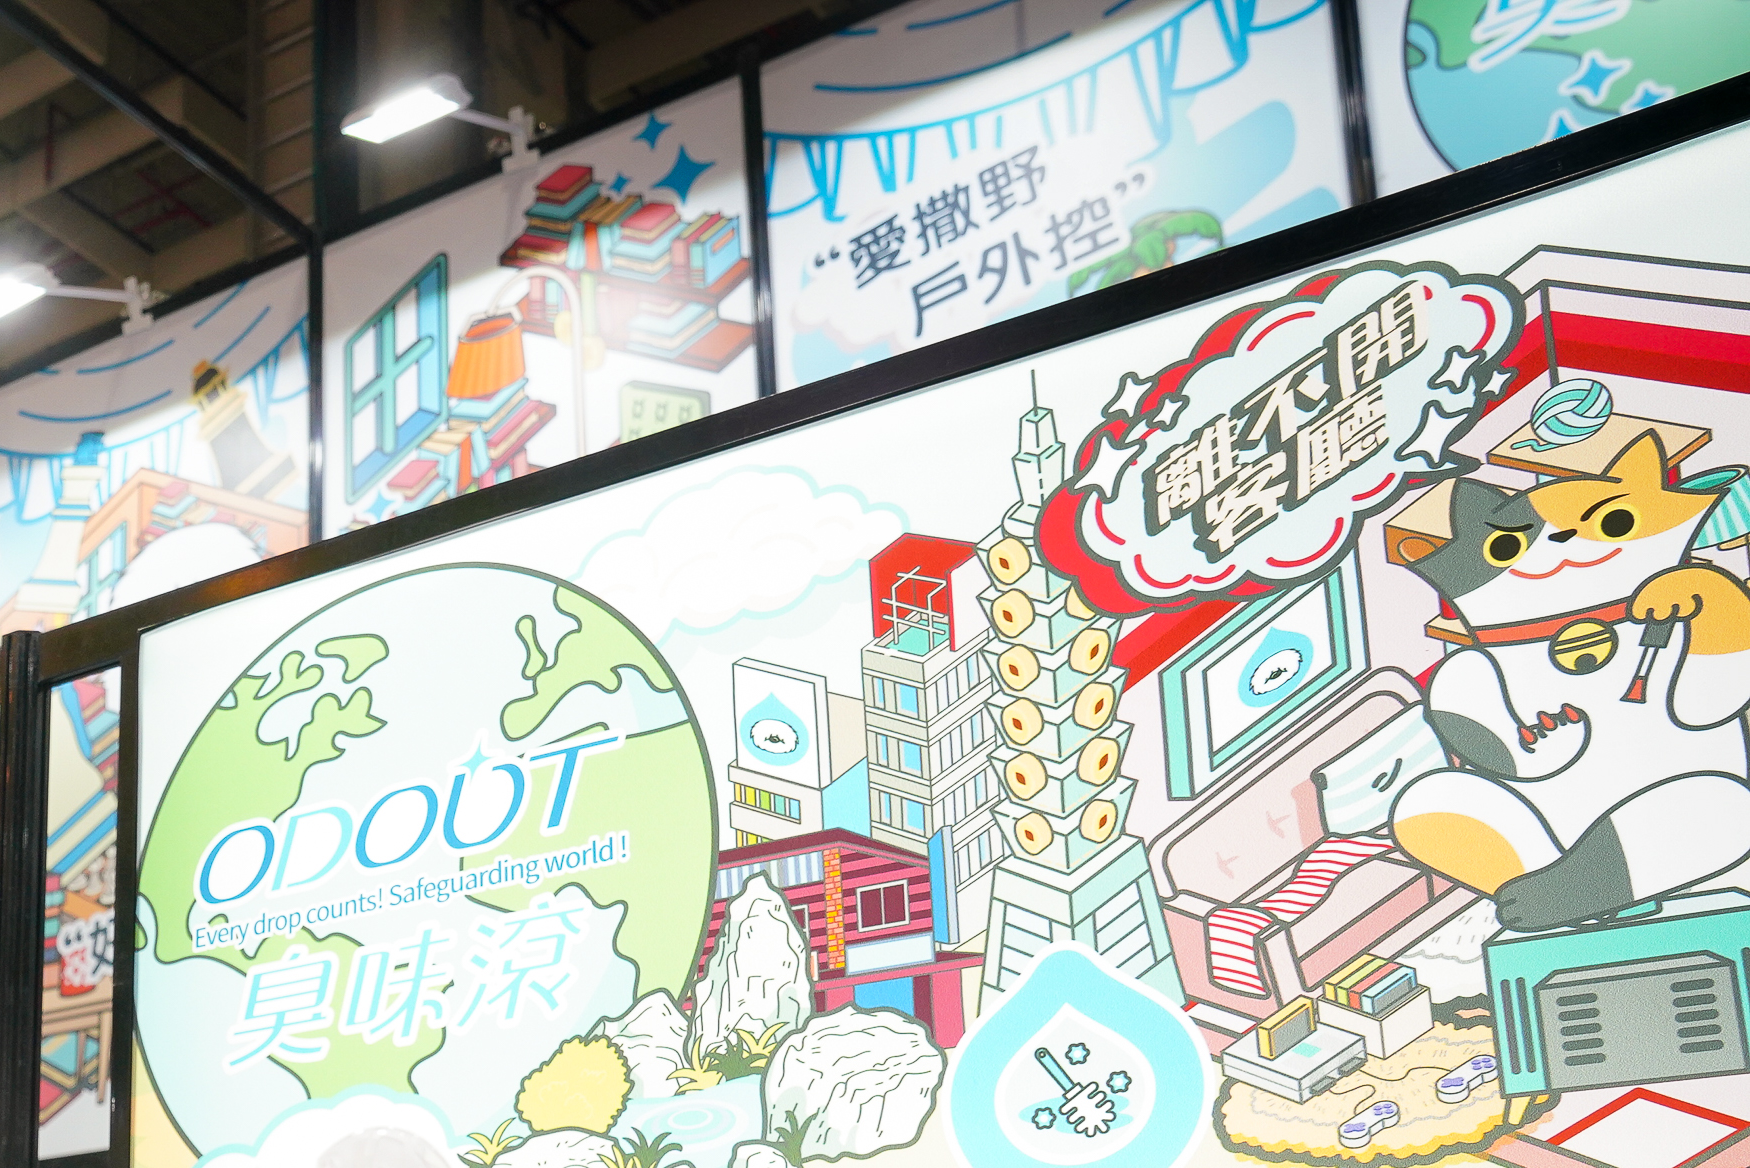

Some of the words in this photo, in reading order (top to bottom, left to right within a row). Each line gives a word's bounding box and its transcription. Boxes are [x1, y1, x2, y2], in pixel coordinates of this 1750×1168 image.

[1147, 280, 1430, 532] 離不開
[1198, 386, 1392, 554] 客廳
[194, 912, 250, 949] Every
[253, 905, 303, 938] drop
[306, 887, 385, 922] counts!
[388, 858, 541, 906] Safeguarding
[545, 836, 615, 871] world
[198, 736, 620, 904] ODOUT
